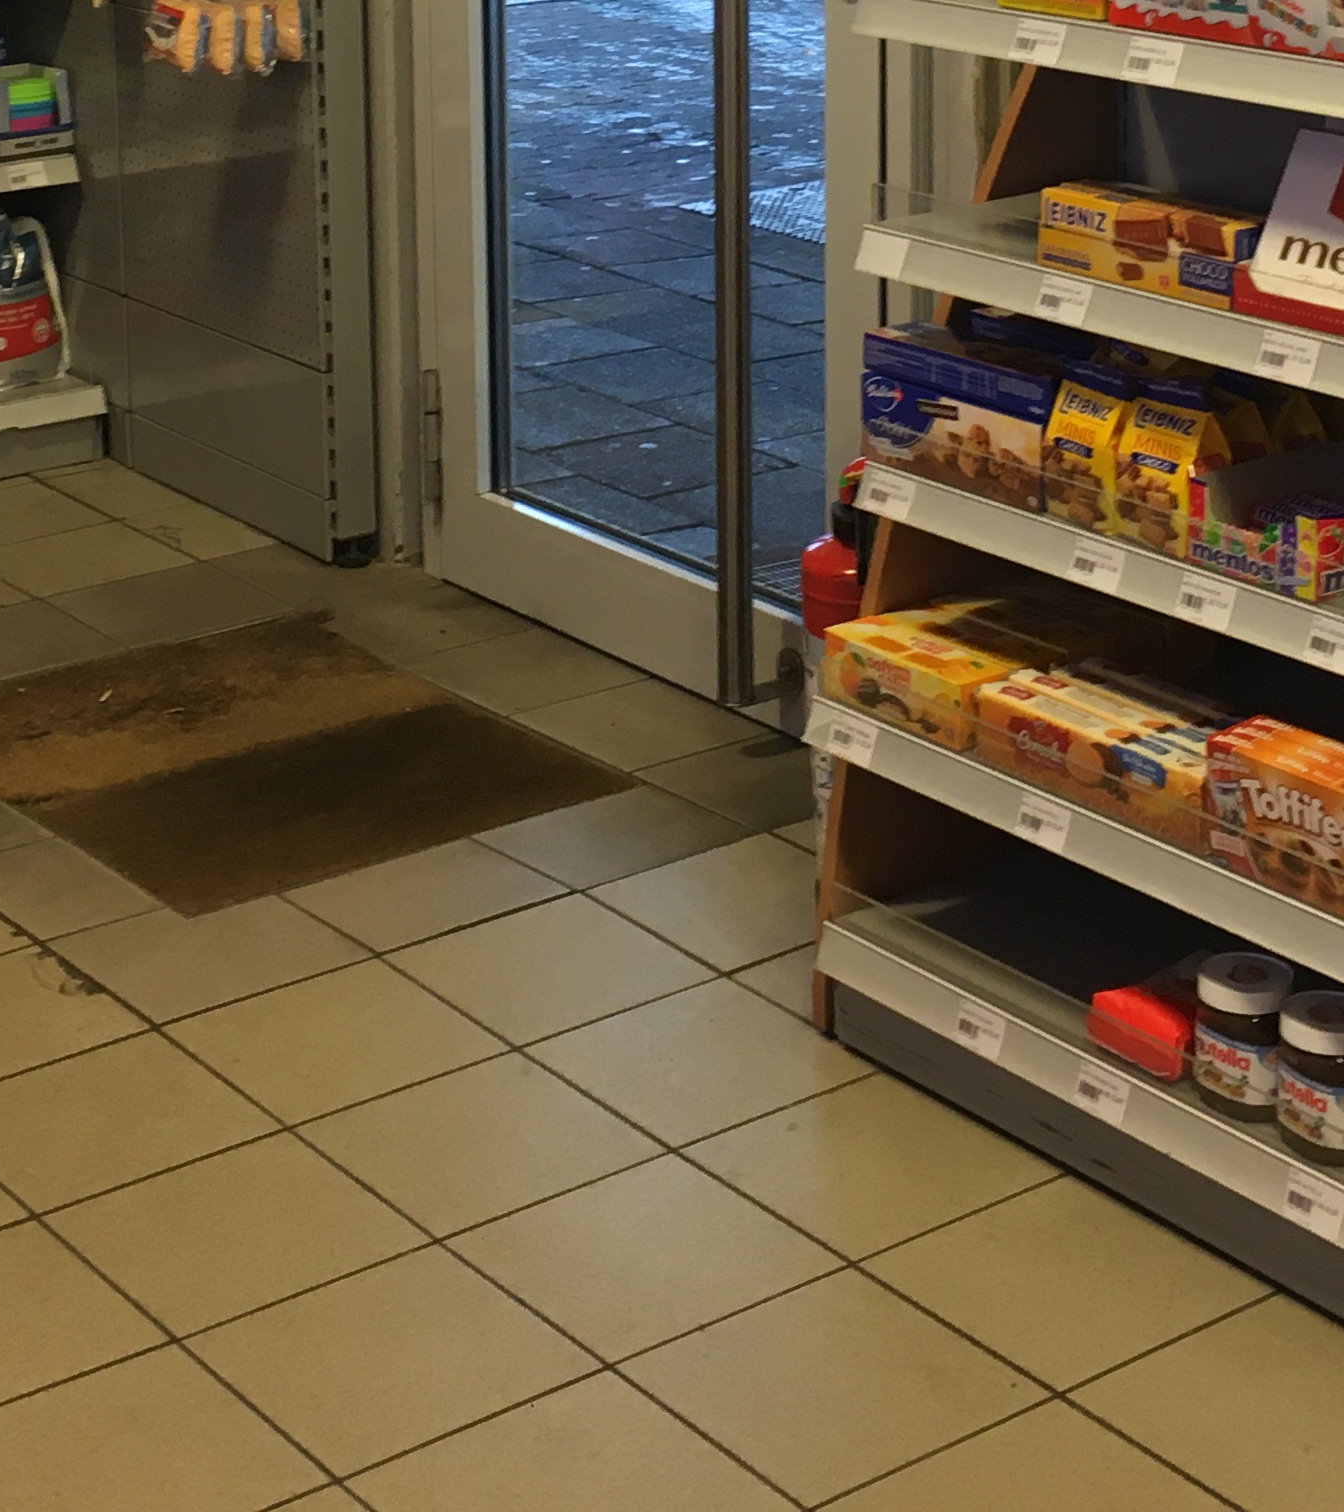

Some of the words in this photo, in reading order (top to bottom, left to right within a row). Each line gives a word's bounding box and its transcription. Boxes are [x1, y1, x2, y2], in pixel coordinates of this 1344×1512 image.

[1045, 196, 1107, 233] LEIBNIZ
[1058, 418, 1095, 445] MINIS
[1133, 401, 1199, 437] LEIBNIZ
[1133, 433, 1182, 461] MINIS
[1190, 541, 1277, 583] mentos
